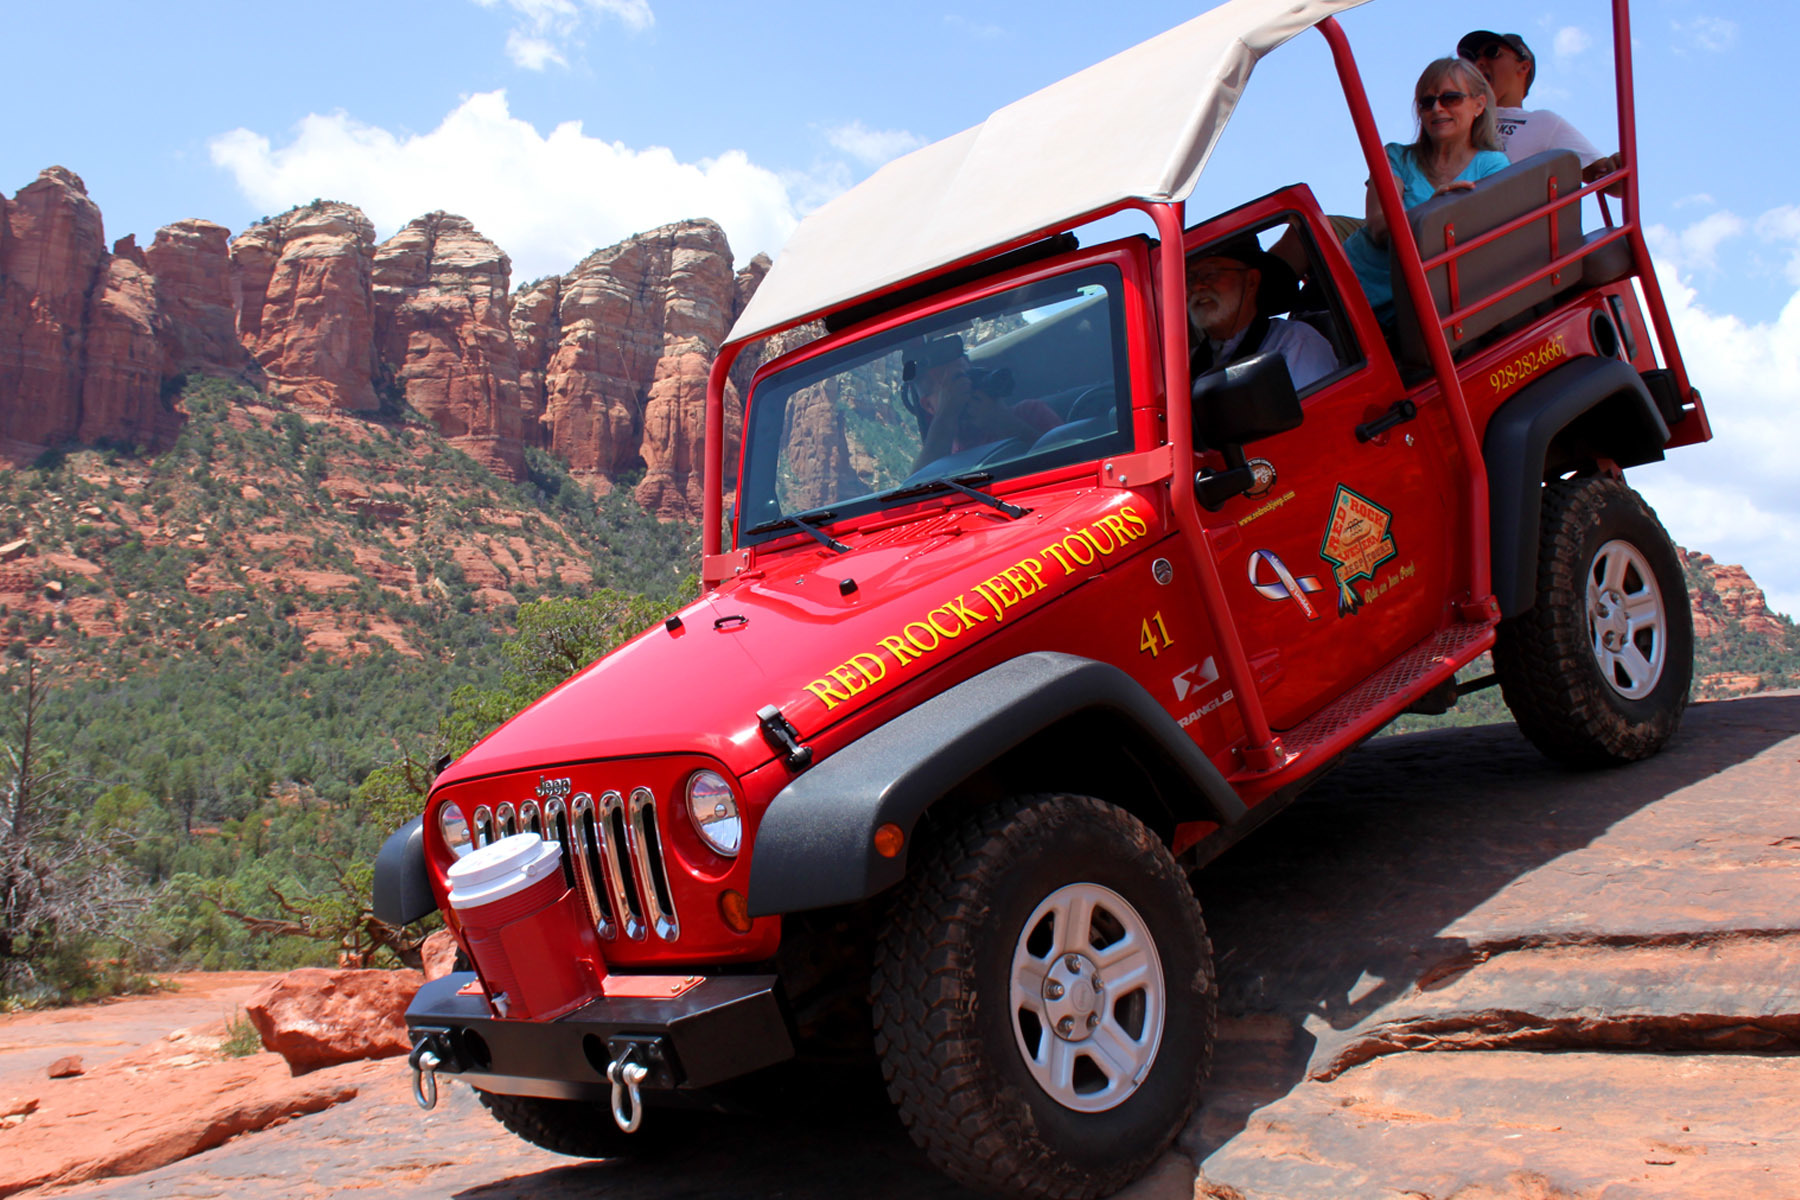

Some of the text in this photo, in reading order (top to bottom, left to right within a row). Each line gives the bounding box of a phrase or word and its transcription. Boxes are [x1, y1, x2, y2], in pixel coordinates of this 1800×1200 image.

[1490, 335, 1566, 394] 928-282-6667
[1327, 498, 1385, 552] RED ROCK
[1344, 542, 1392, 577] JEEP TOURS
[804, 506, 1148, 711] RED ROCK JEEP TOURS
[1140, 610, 1174, 657] 41
[1177, 689, 1234, 728] RANGLE
[535, 775, 571, 797] Jeep
